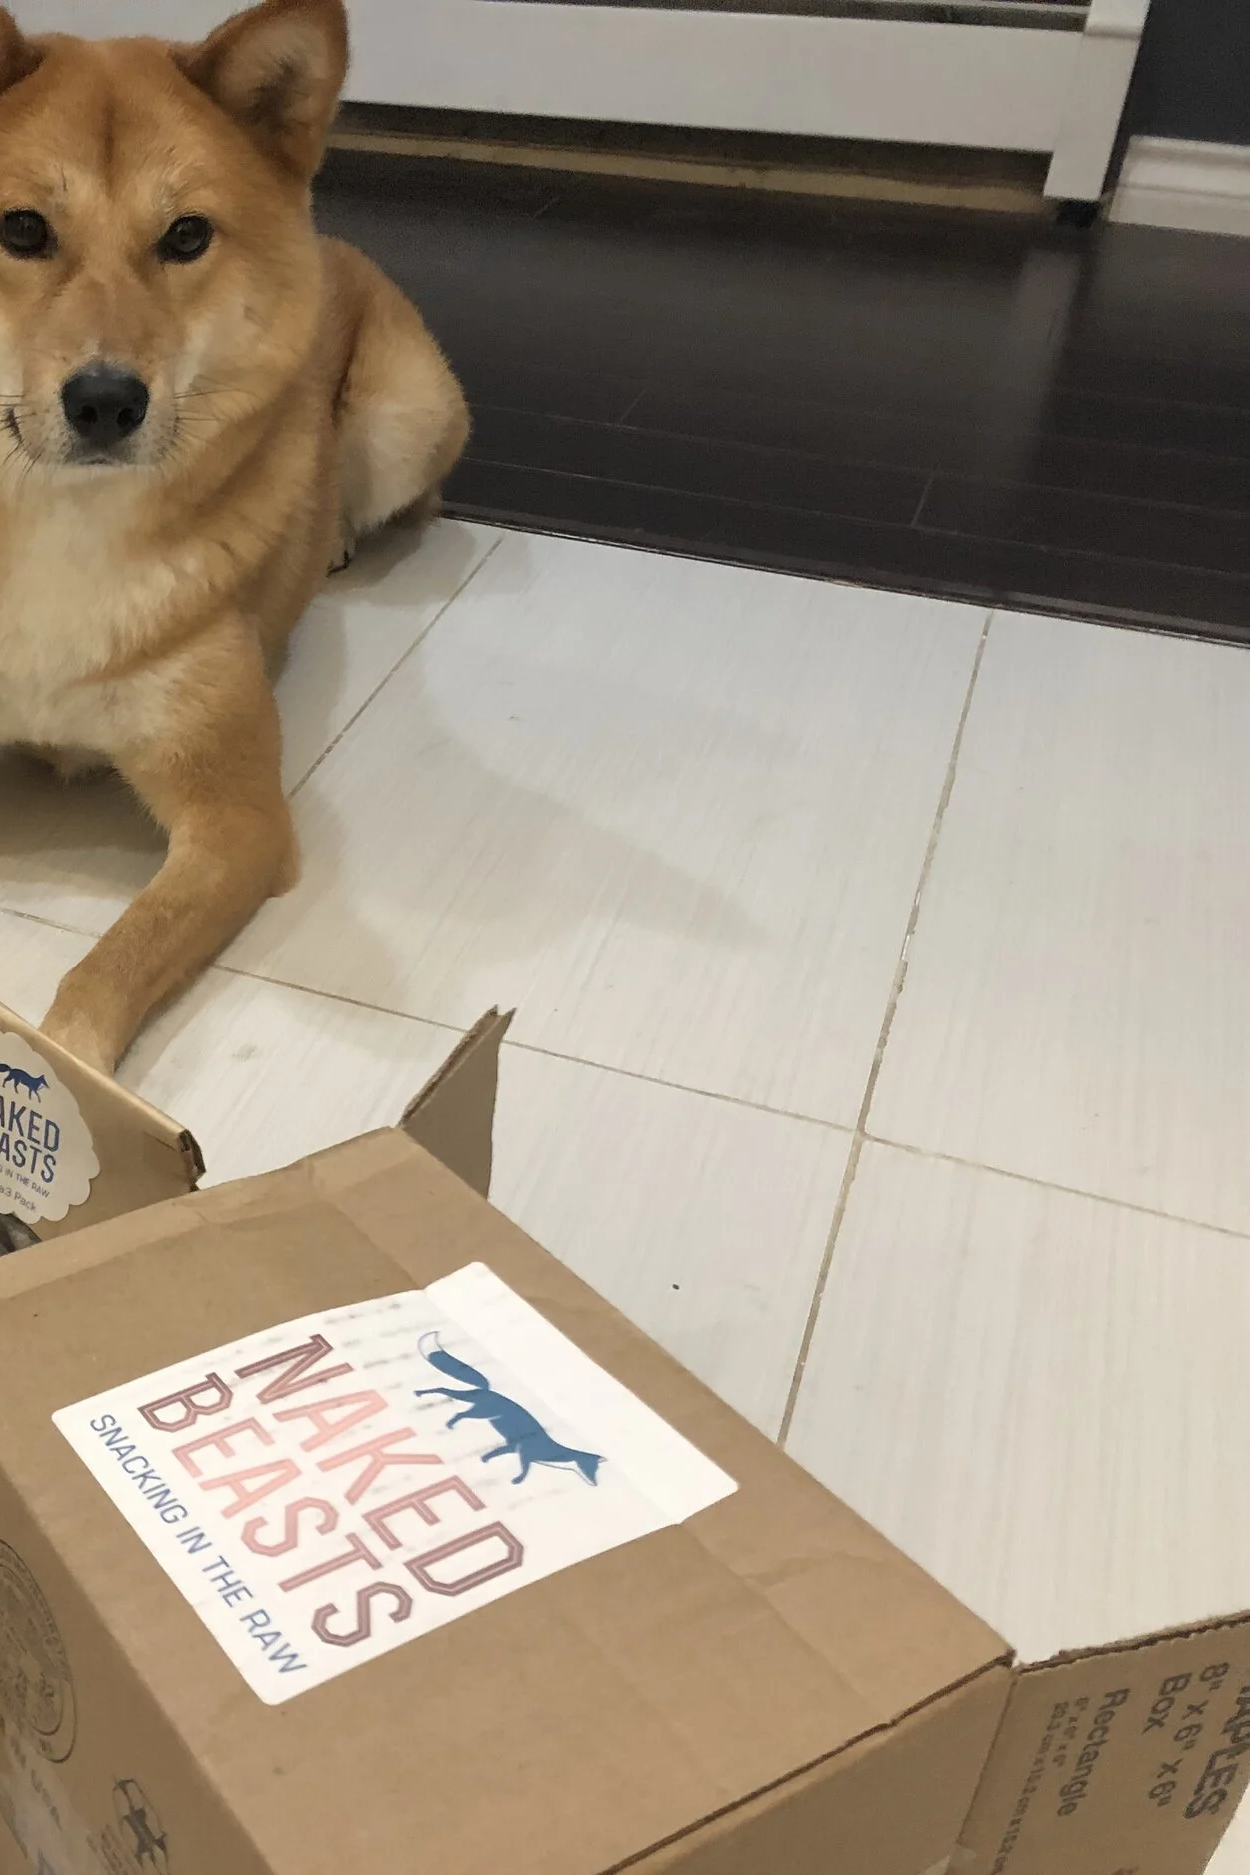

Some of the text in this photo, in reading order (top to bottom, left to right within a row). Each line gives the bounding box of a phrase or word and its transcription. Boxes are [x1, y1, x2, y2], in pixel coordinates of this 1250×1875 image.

[5, 1168, 14, 1177] IN
[16, 1173, 30, 1187] THE
[32, 1182, 50, 1198] RAW
[14, 1191, 37, 1211] Pack
[137, 1371, 413, 1648] BEASTS
[233, 1333, 524, 1597] NAKED
[90, 1414, 308, 1674] SNACKING IN THE RAW
[1057, 1687, 1130, 1817] Rectangle
[1141, 1673, 1192, 1736] Box
[1149, 1662, 1230, 1807] 8" x 6" x 6"
